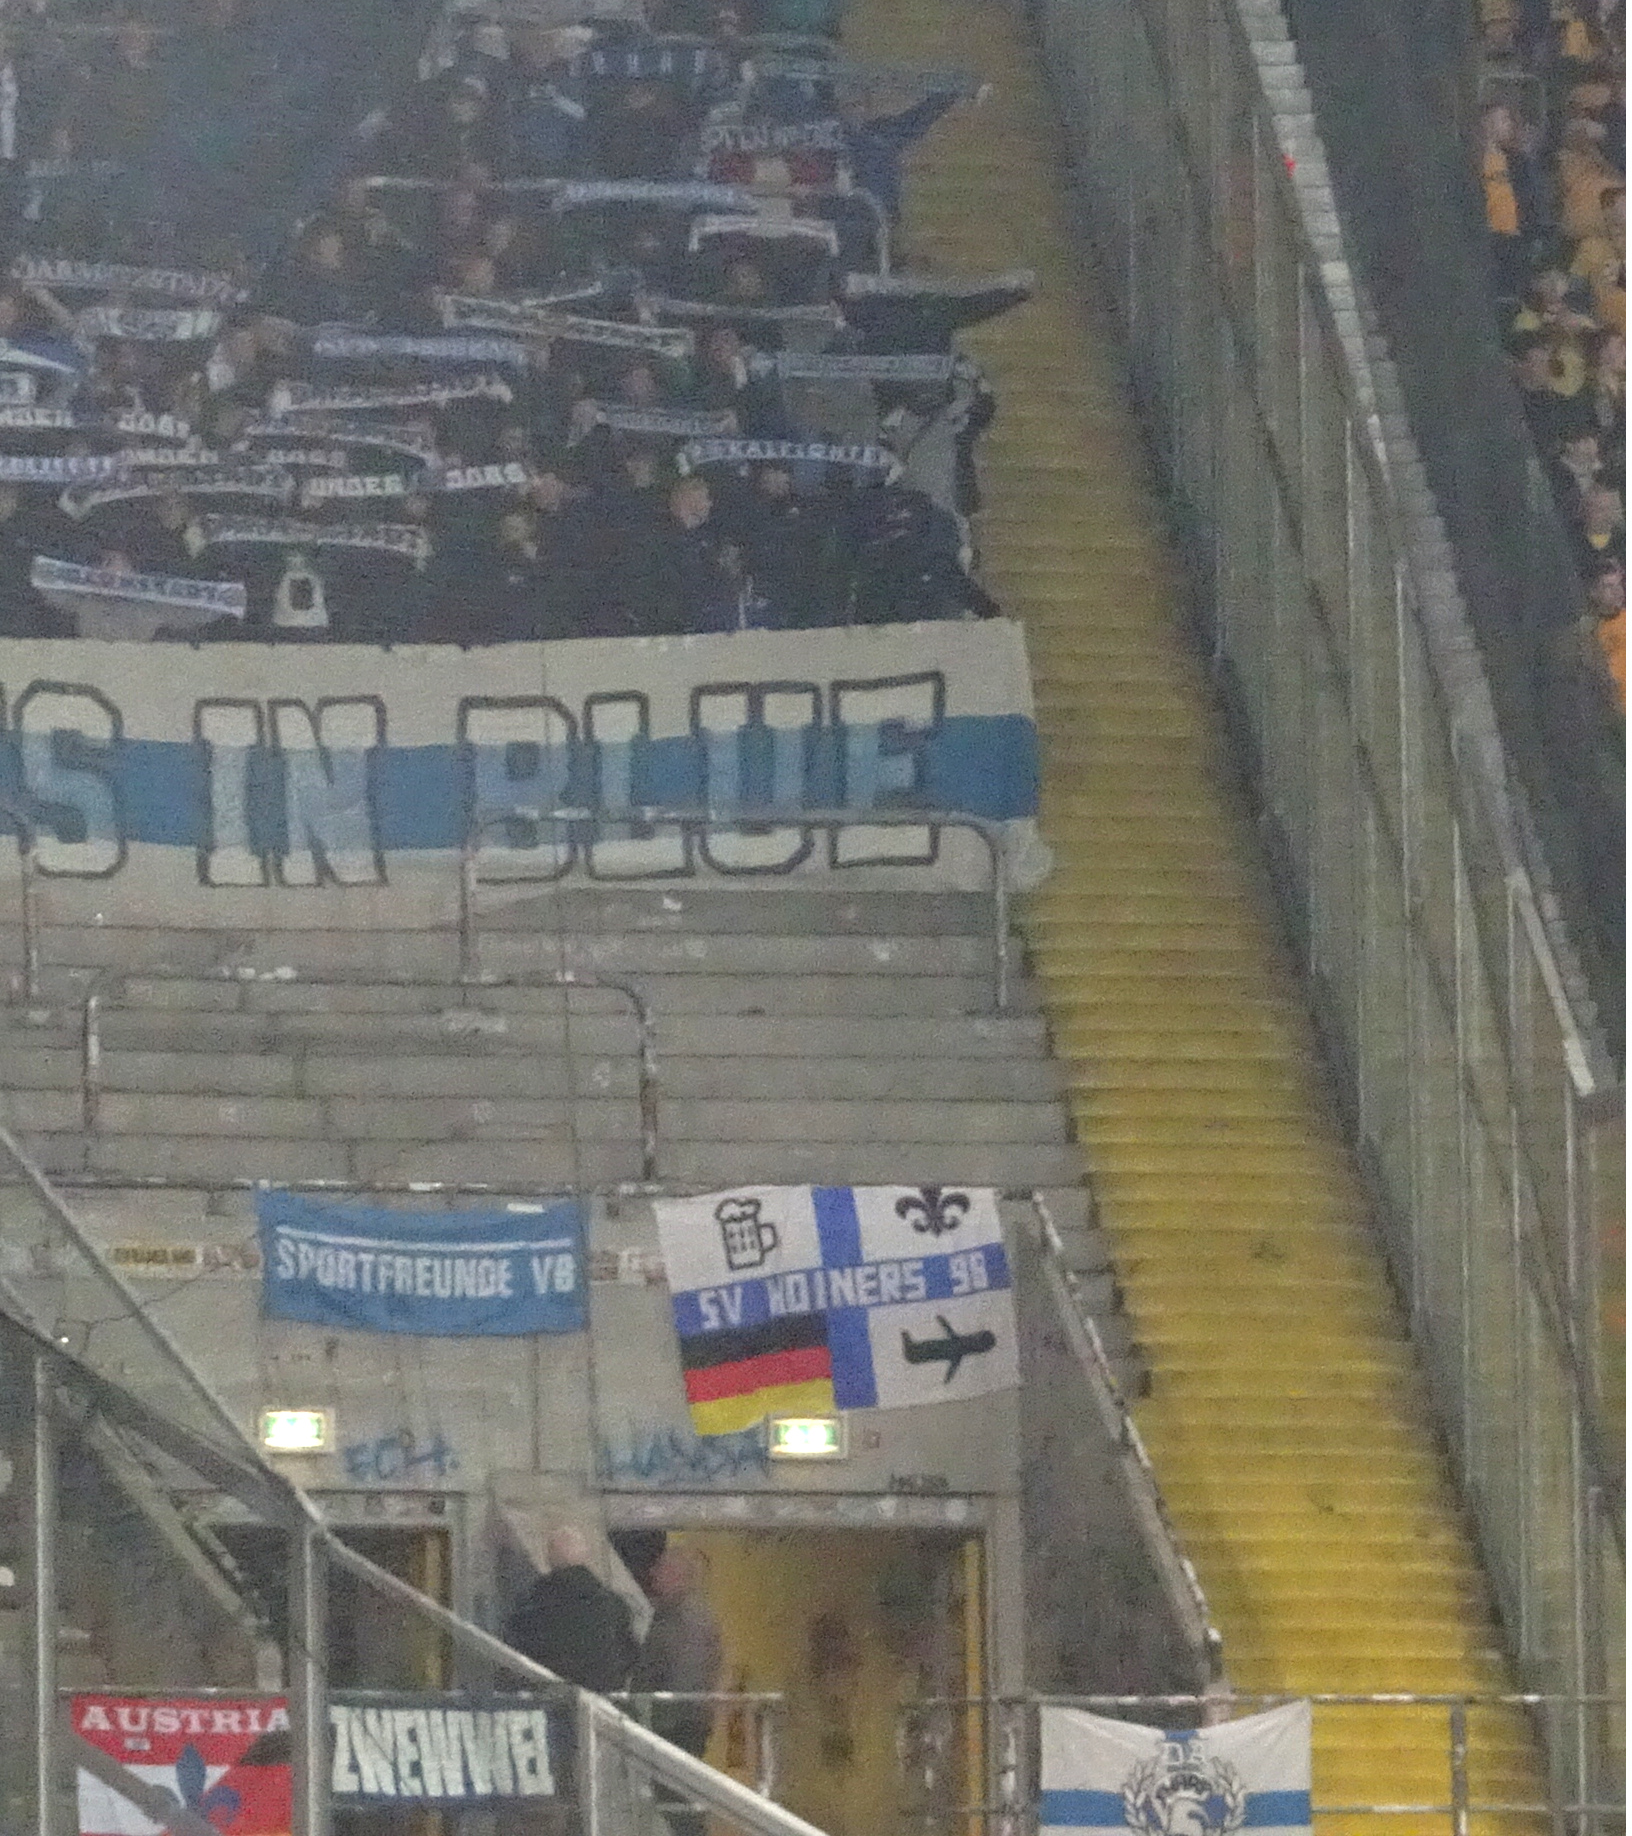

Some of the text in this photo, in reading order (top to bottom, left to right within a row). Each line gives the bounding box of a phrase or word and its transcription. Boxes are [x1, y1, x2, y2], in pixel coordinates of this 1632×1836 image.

[193, 694, 388, 887] IN
[458, 670, 945, 884] BLUE
[276, 1236, 515, 1300] SPORTFREUNDE
[699, 1287, 745, 1331] SV
[948, 1252, 991, 1295] 98
[81, 1705, 292, 1734] AUSTRIA
